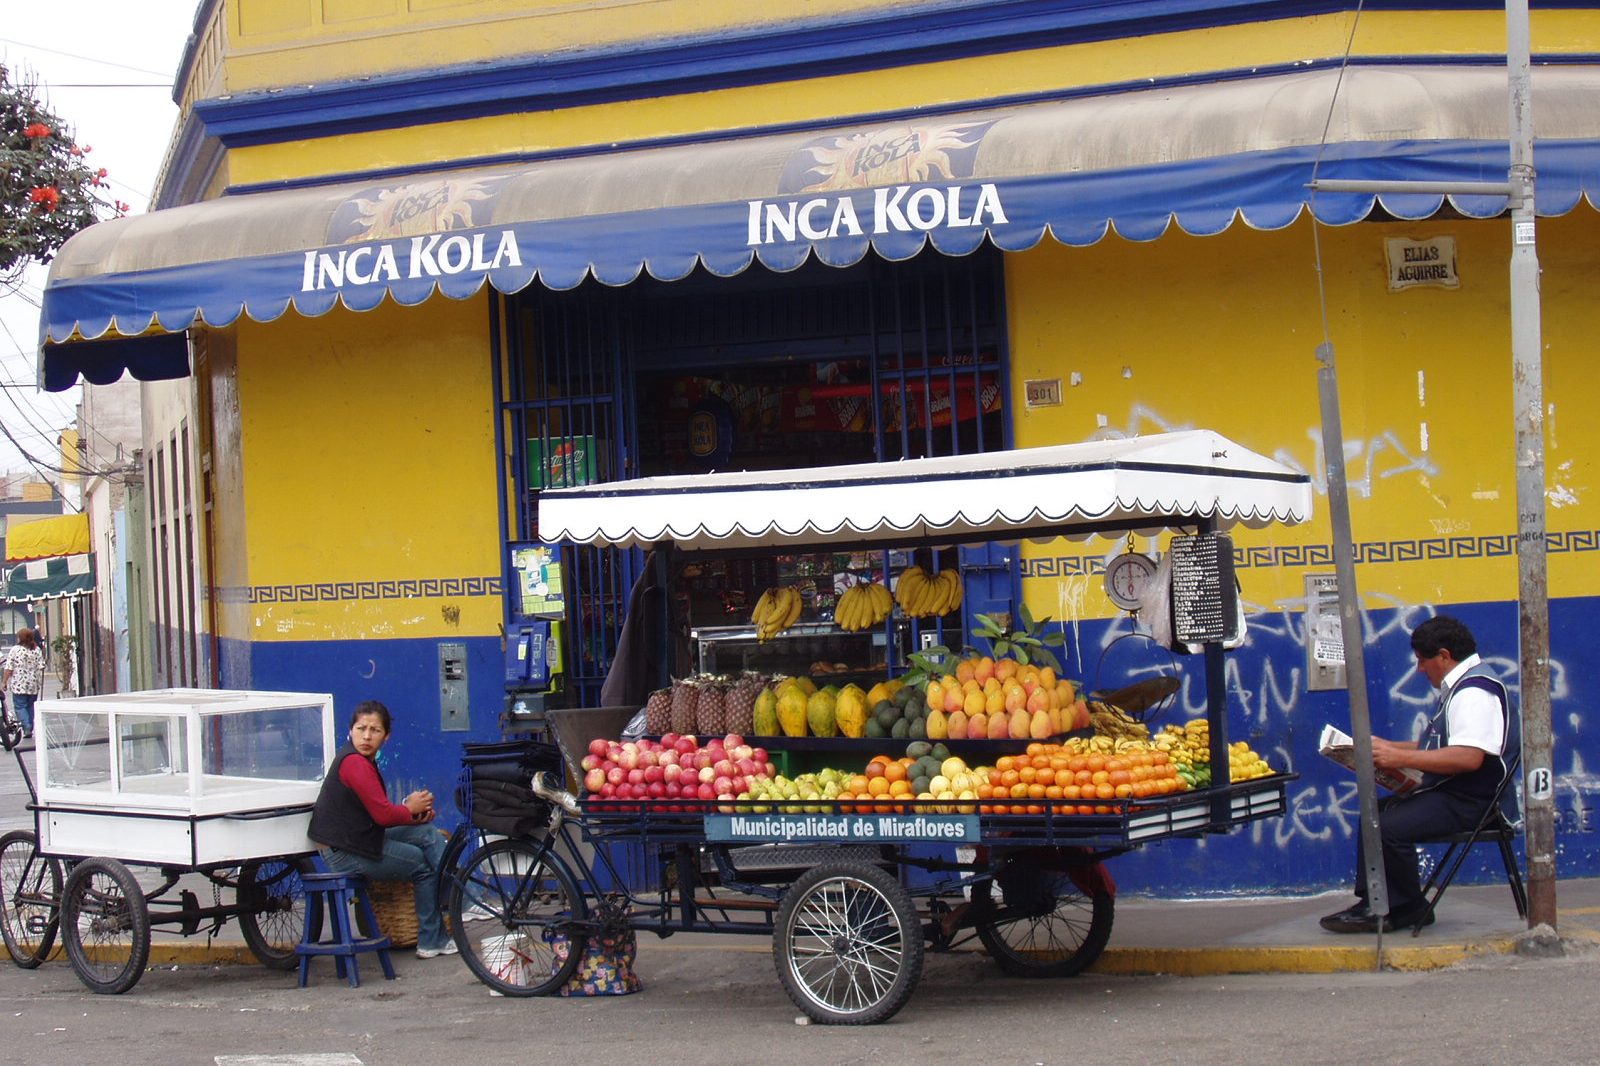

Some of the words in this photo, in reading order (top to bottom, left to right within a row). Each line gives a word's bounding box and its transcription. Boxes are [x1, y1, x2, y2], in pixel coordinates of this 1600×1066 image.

[853, 142, 920, 177] KOLA
[746, 196, 864, 247] INCA
[873, 183, 1009, 235] KOLA
[301, 244, 400, 292] INCA
[408, 229, 523, 279] KOLA
[1403, 246, 1440, 262] ELIAS
[1397, 264, 1449, 282] AGUIRRE
[1033, 388, 1051, 400] 301
[730, 816, 849, 841] Municipalidad
[852, 816, 875, 838] de
[878, 816, 965, 838] Miraflores
